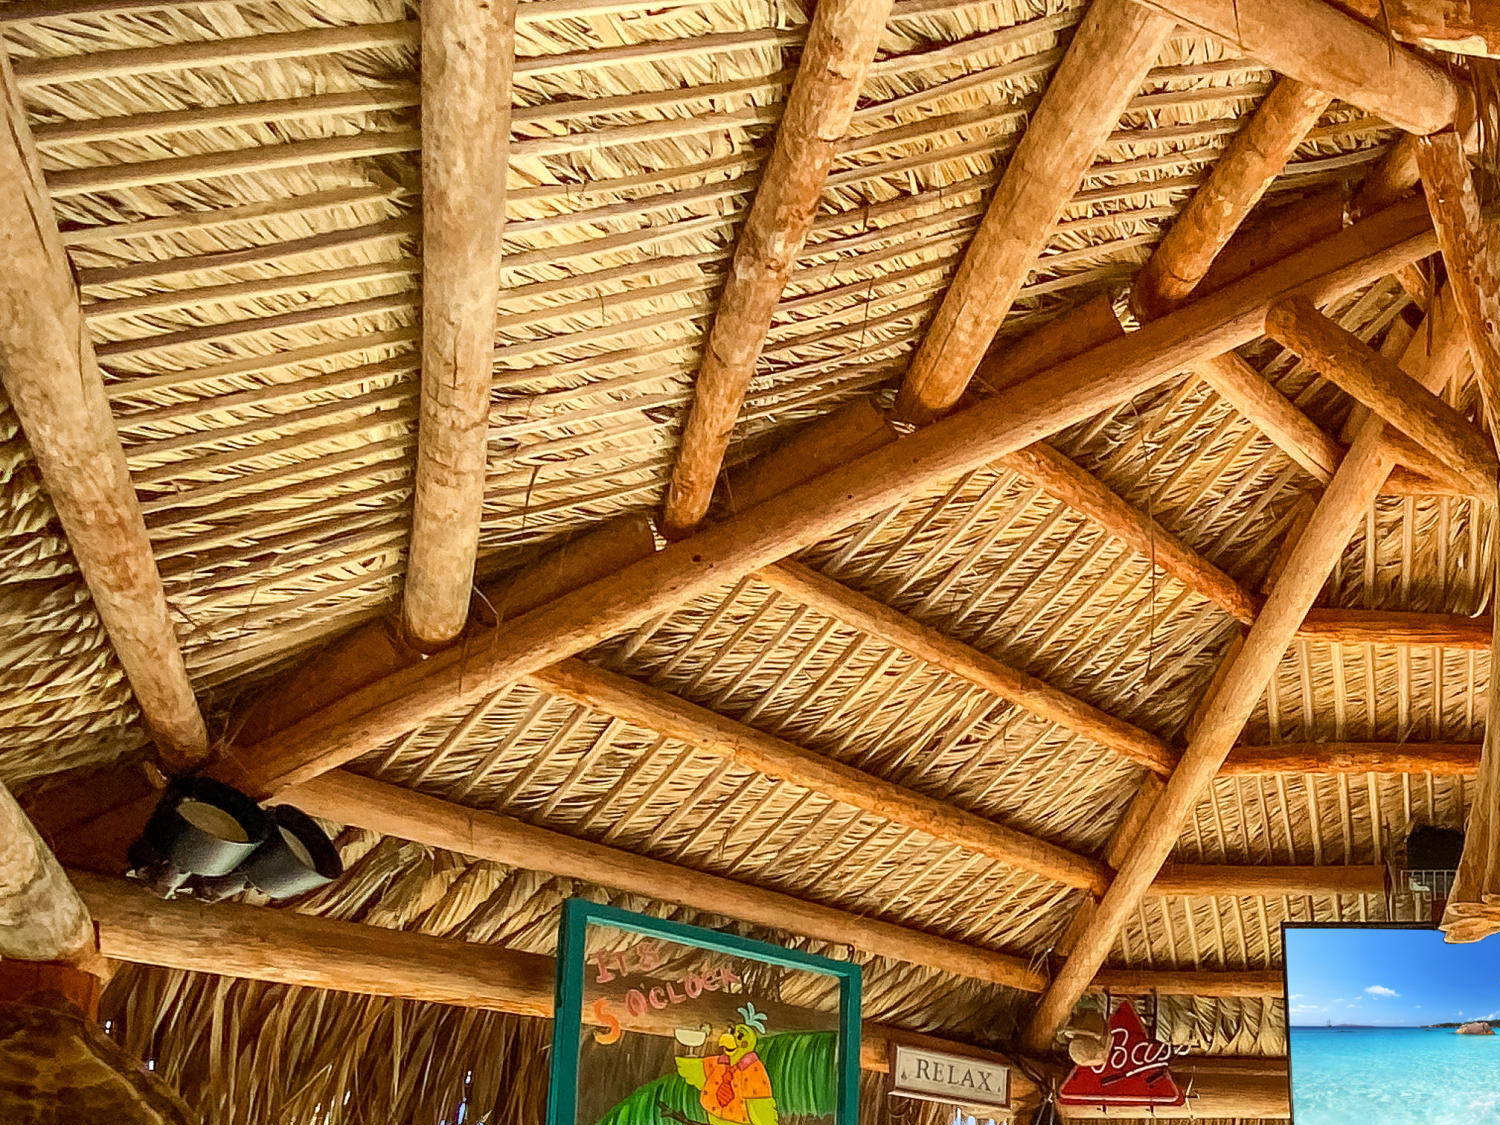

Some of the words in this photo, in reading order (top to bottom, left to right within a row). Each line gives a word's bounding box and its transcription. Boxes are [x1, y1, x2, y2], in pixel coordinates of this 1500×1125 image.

[593, 996, 621, 1045] 5
[1091, 1028, 1191, 1074] Bass
[915, 1058, 992, 1092] RELAX
